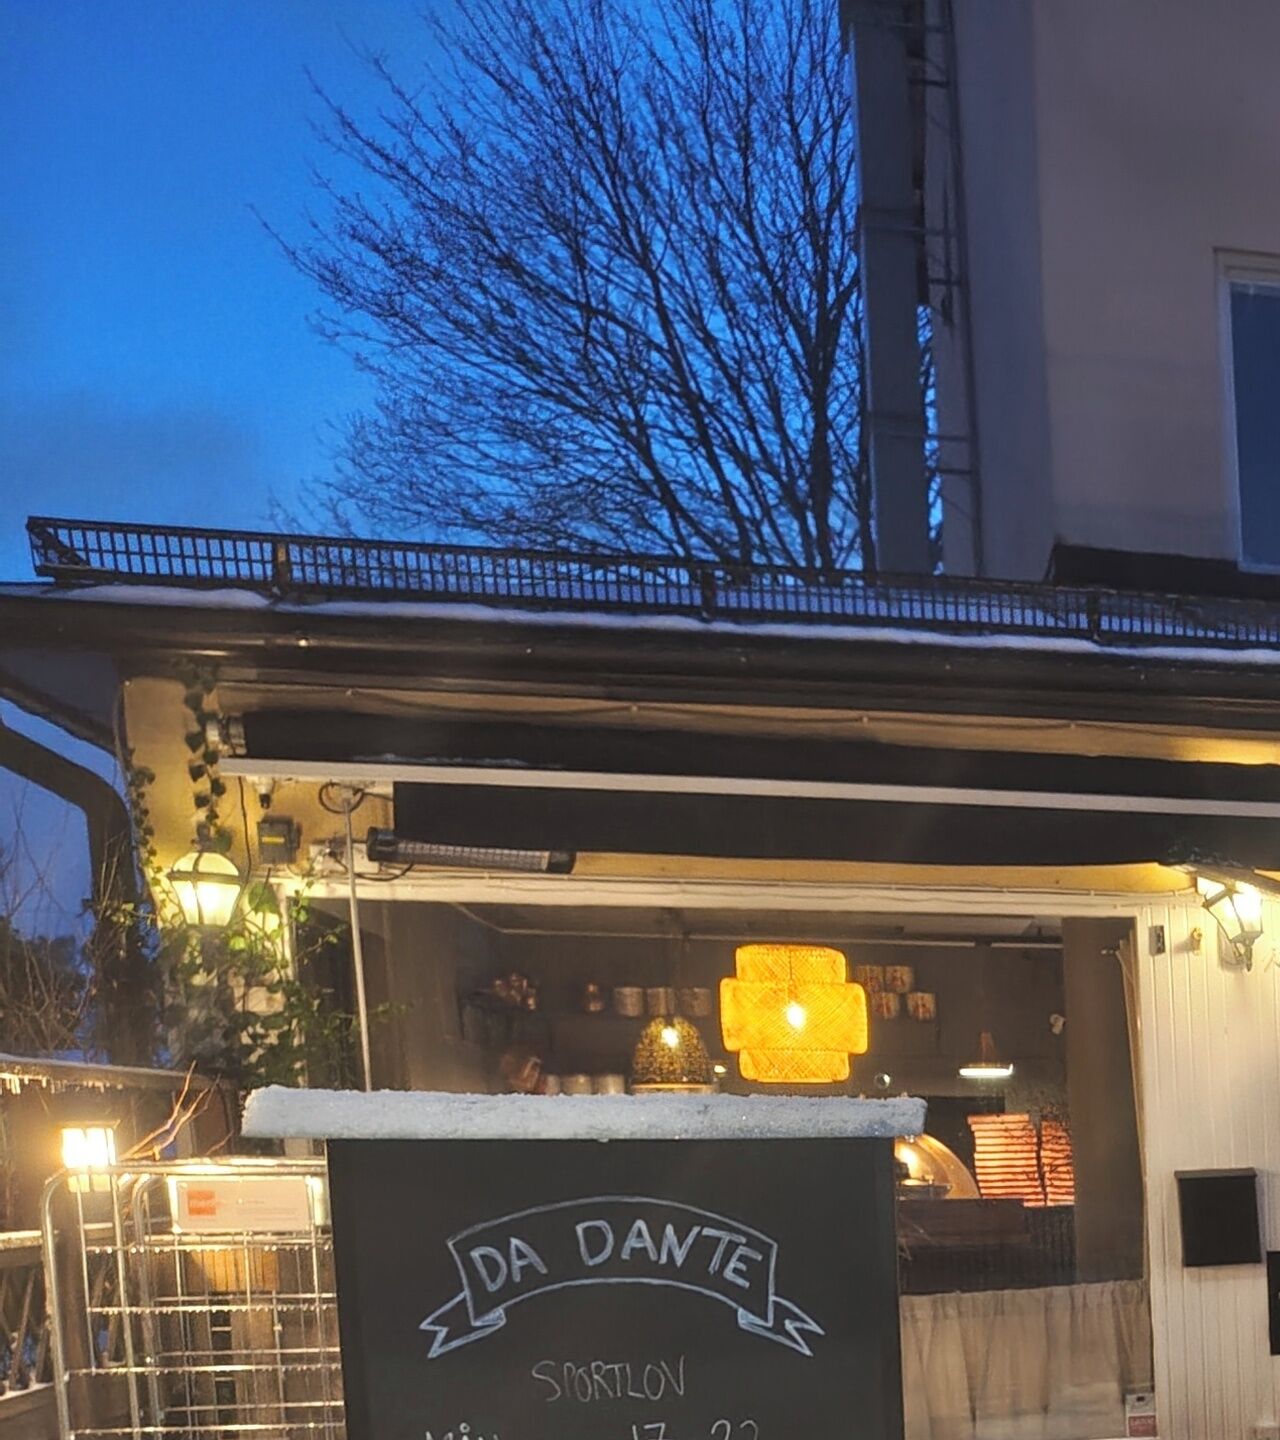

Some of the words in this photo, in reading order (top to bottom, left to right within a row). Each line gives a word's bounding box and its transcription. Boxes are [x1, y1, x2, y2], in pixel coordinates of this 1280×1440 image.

[470, 1237, 548, 1292] DA
[575, 1219, 763, 1289] DANTE
[532, 1355, 685, 1402] SPORTLOV
